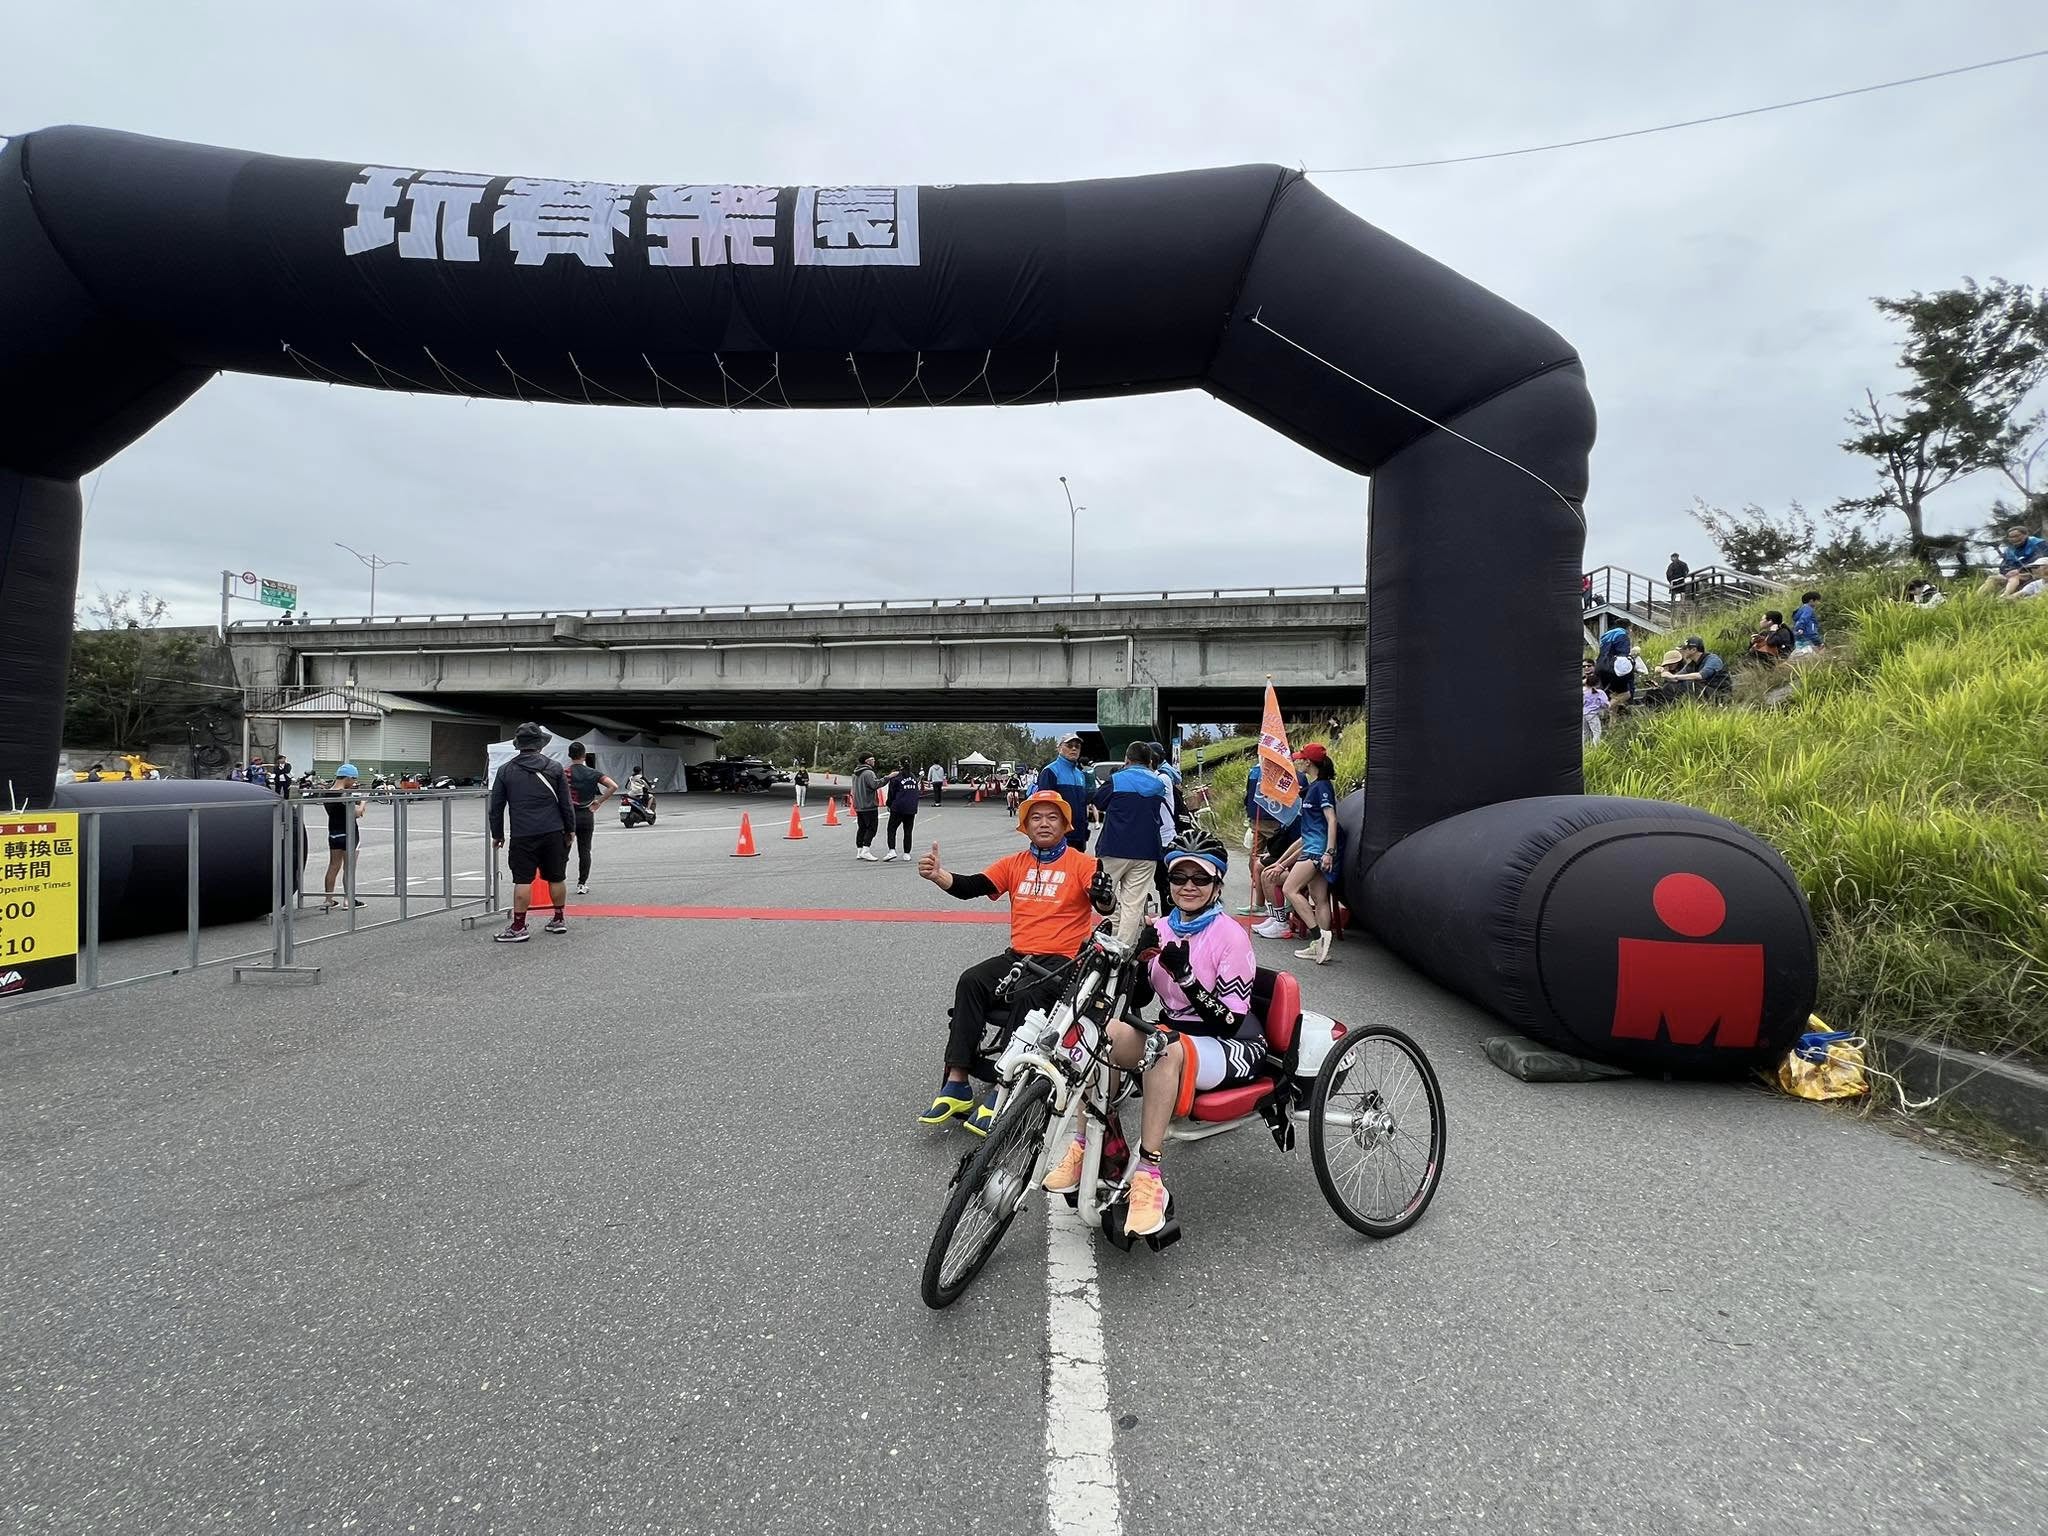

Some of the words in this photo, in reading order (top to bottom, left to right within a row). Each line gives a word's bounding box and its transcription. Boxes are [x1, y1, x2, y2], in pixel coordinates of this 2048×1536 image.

[4, 839, 74, 859] 轉換區
[0, 861, 51, 880] 時間
[42, 882, 71, 890] Times
[1070, 1048, 1082, 1061] 14
